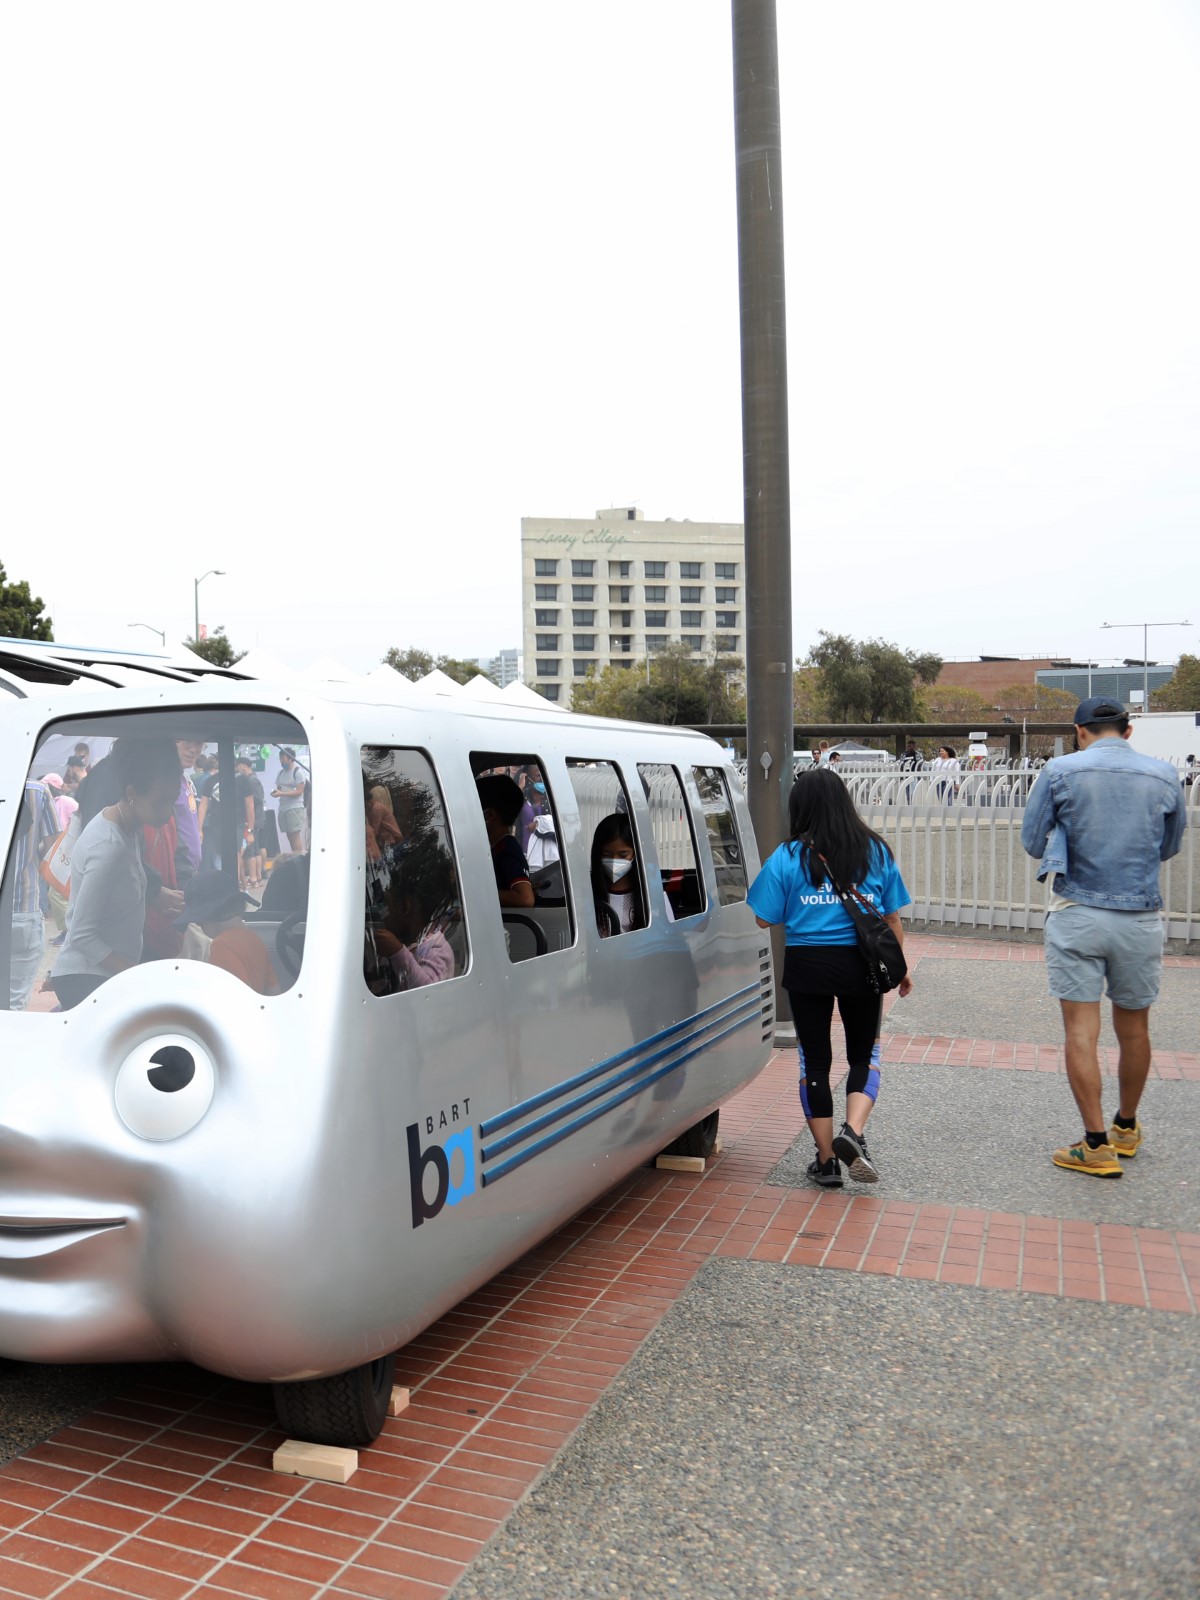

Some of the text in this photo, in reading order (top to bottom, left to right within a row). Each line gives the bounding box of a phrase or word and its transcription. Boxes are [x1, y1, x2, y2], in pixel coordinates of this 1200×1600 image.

[537, 528, 624, 552] Laney College
[800, 893, 875, 905] VOLUNER
[817, 883, 858, 893] EVT
[426, 1098, 470, 1135] BART
[406, 1122, 476, 1229] ba
